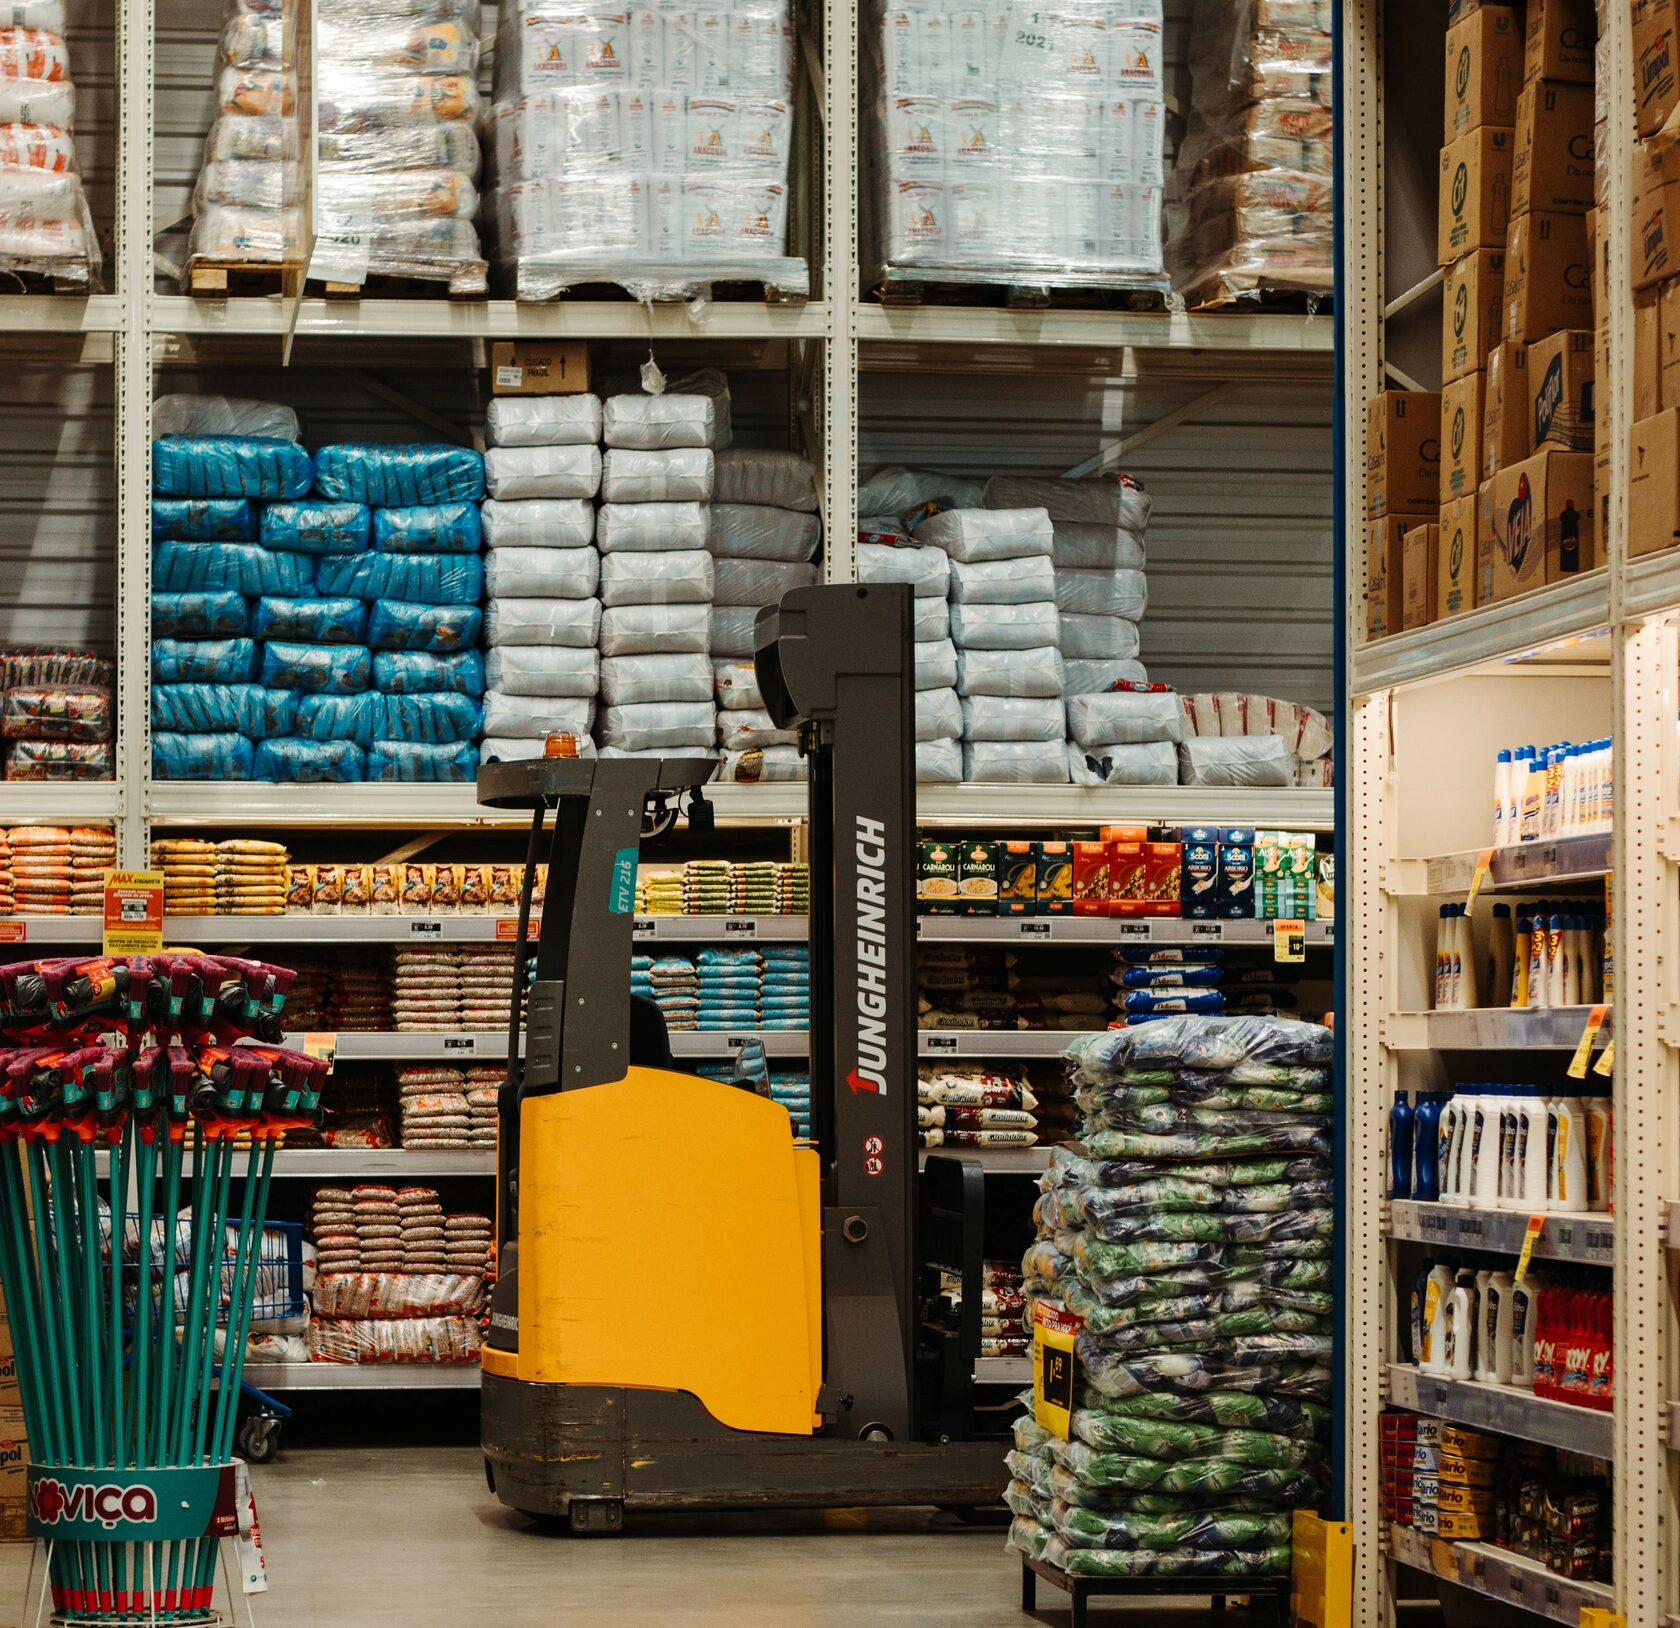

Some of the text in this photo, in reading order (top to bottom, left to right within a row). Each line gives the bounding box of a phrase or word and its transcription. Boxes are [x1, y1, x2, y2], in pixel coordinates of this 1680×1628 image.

[1190, 852, 1209, 860] Scotti
[1227, 853, 1246, 861] Scotti
[922, 863, 955, 871] CARNAROLI
[963, 863, 996, 871] CARNAROLI
[108, 874, 133, 887] MAX
[617, 860, 632, 913] ETV 216
[1551, 935, 1558, 945] 3
[855, 815, 887, 1096] JUNGHEINRICH
[1551, 947, 1558, 956] 2
[989, 1114, 1029, 1123] Gladiador
[988, 1134, 1027, 1142] Gladiador
